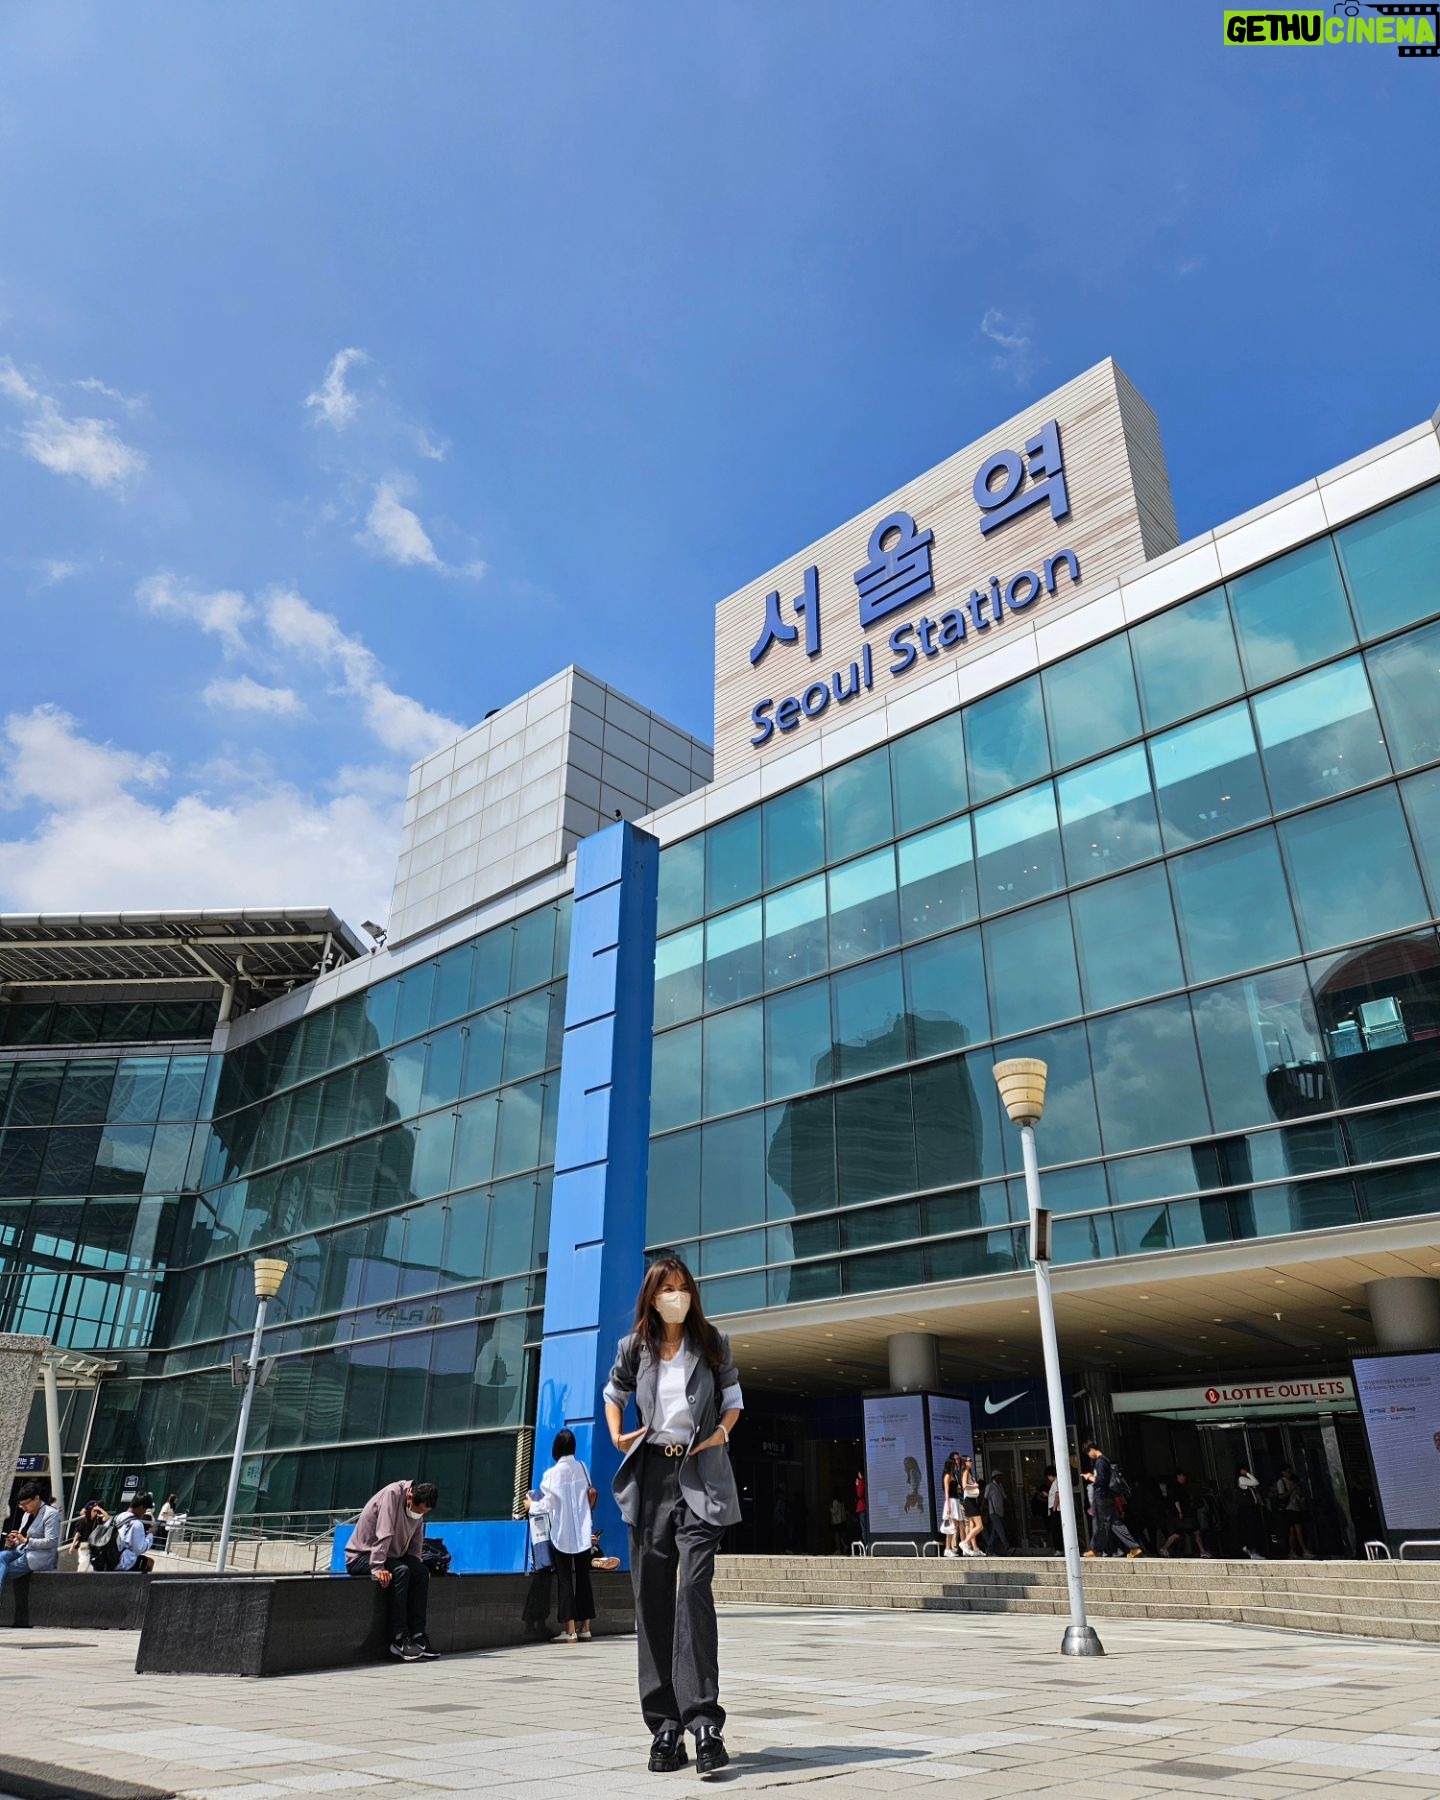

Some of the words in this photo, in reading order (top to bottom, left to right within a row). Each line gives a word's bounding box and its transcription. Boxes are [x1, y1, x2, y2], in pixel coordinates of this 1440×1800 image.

[751, 643, 874, 746] Seoul
[889, 548, 1081, 674] Station
[1222, 1386, 1275, 1401] LOTTE
[1278, 1381, 1345, 1398] OUTLETS
